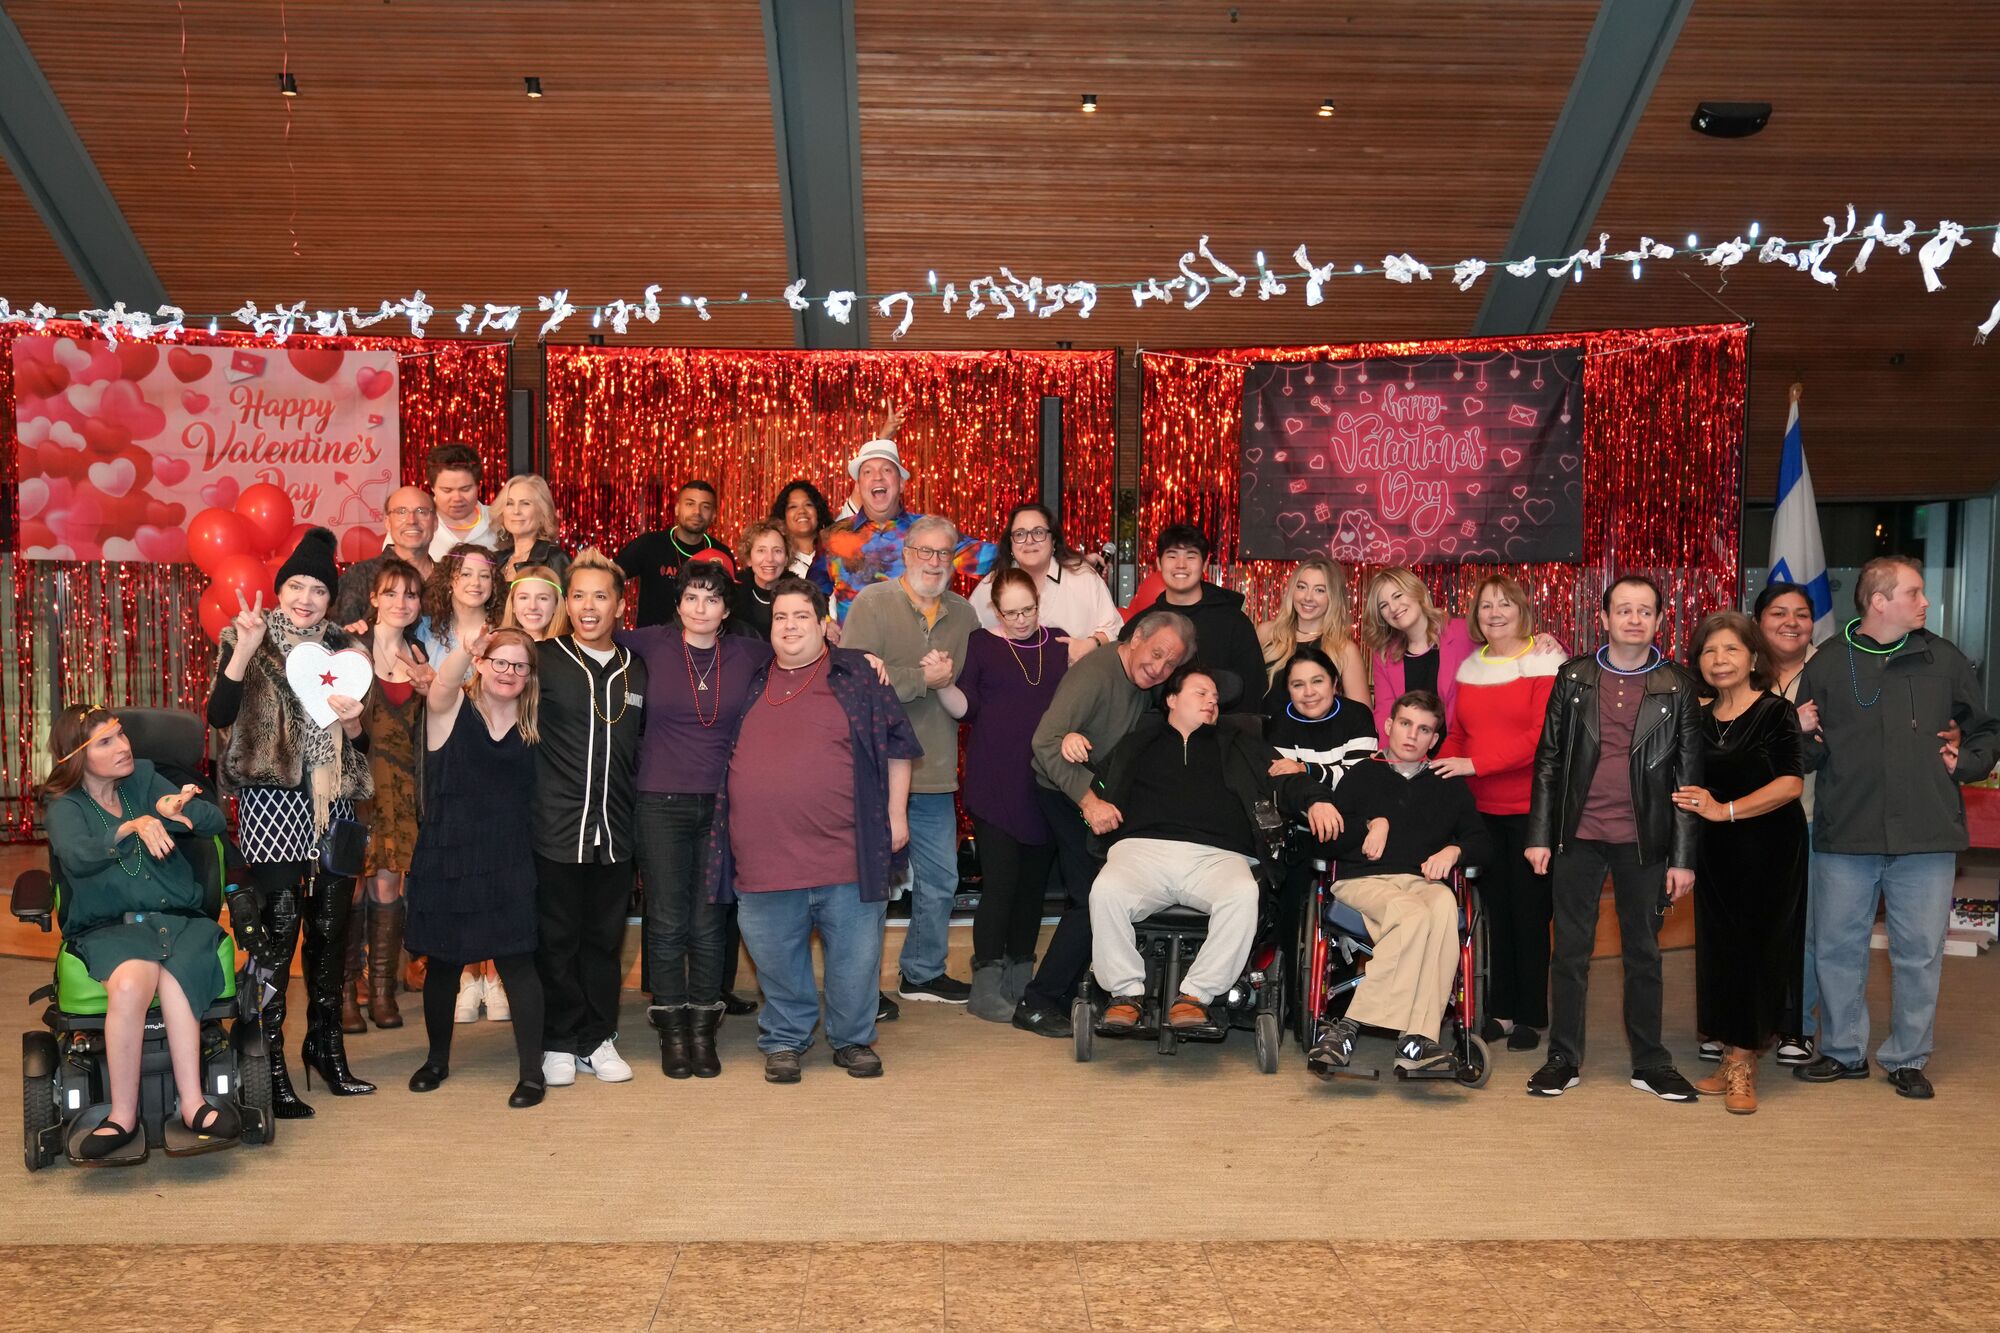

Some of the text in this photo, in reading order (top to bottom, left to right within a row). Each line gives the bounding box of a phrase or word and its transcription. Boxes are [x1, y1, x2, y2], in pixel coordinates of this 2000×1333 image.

[229, 385, 336, 435] Happy
[1382, 384, 1448, 421] happy
[181, 421, 382, 472] Valentine's
[1331, 412, 1487, 473] Valentine's
[1380, 471, 1455, 537] Day
[1403, 1041, 1420, 1059] N
